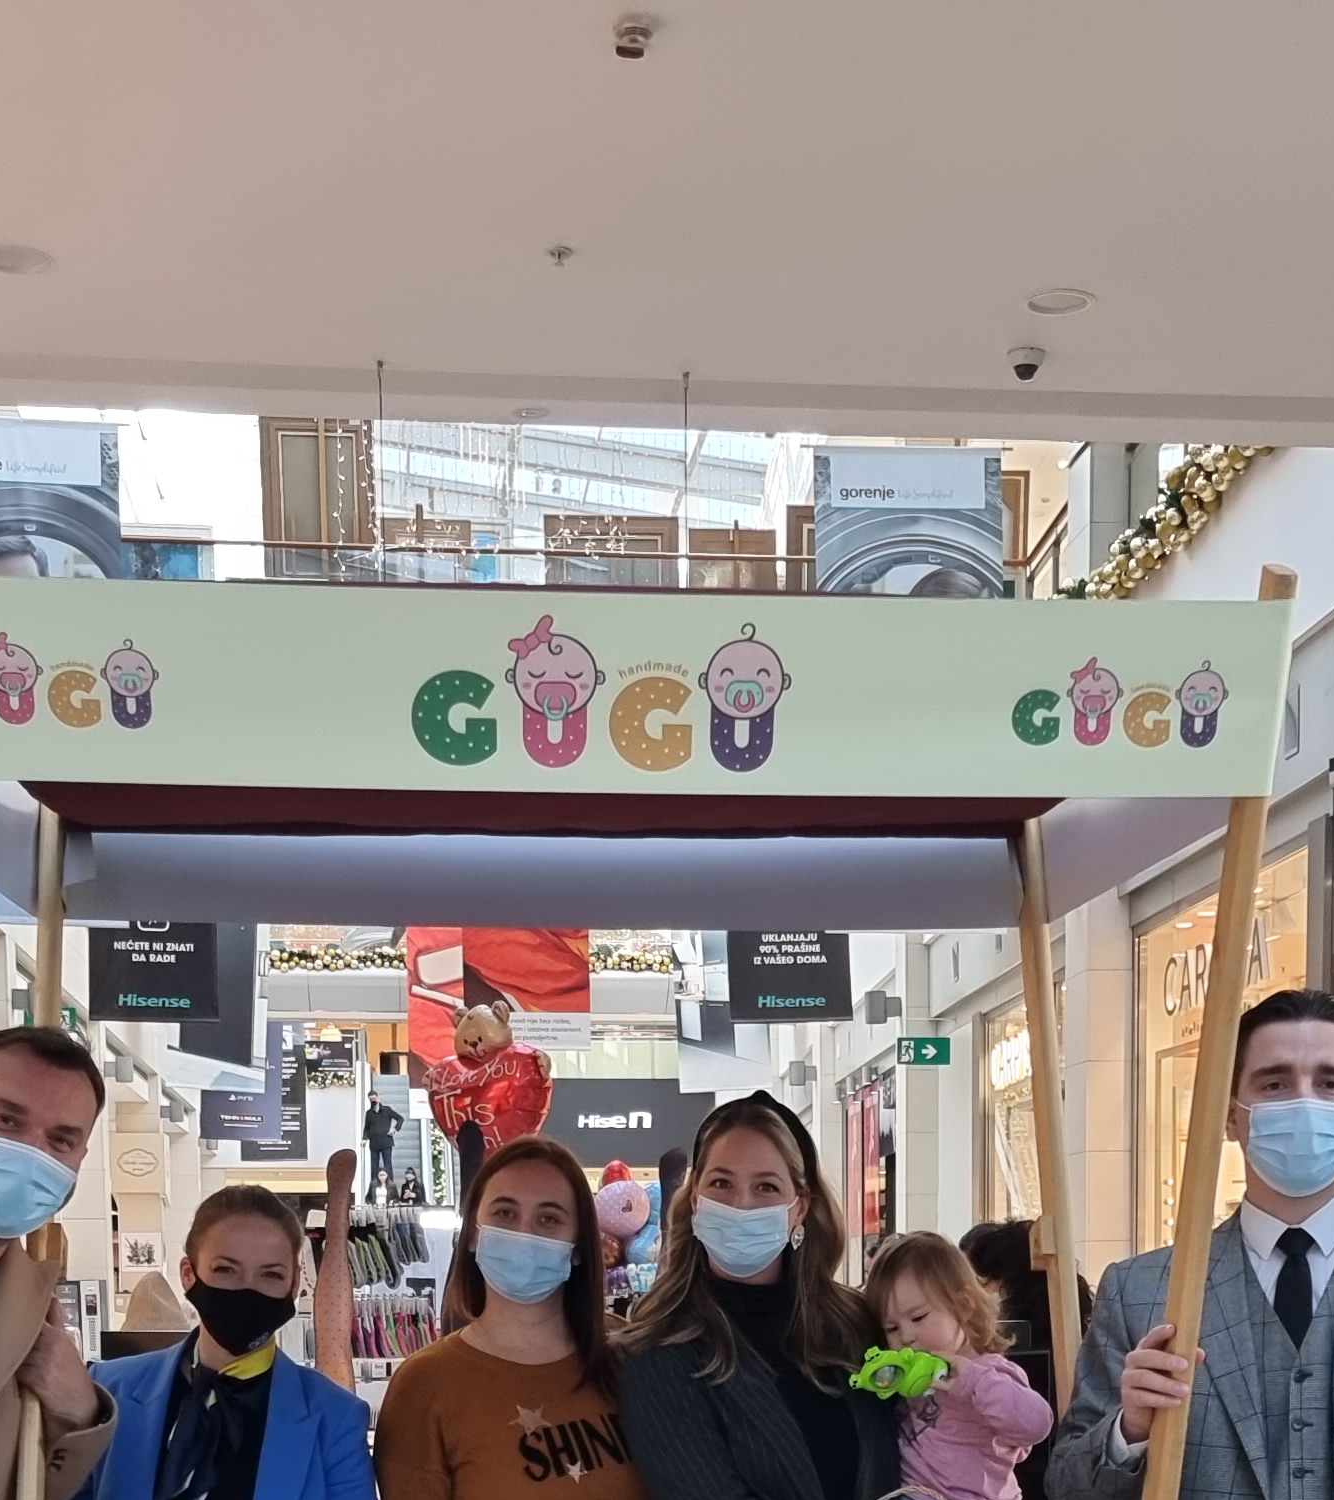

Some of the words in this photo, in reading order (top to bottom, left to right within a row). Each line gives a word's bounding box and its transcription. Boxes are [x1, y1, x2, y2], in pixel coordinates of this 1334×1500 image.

[839, 485, 895, 502] gorenje
[617, 659, 690, 679] handmade
[411, 640, 775, 772] GUGU
[1012, 670, 1219, 747] GUGU
[762, 933, 818, 943] UKLANJAJU
[152, 941, 164, 951] NI
[166, 942, 194, 953] ZNATI
[759, 945, 779, 954] 90%
[782, 942, 821, 954] PRAŠINE
[132, 953, 146, 963] DA
[149, 953, 176, 964] RADE
[753, 956, 762, 965] IZ
[796, 955, 827, 965] DOMA
[118, 993, 191, 1009] Hisense
[758, 995, 826, 1009] Hisense
[433, 1088, 496, 1132] This
